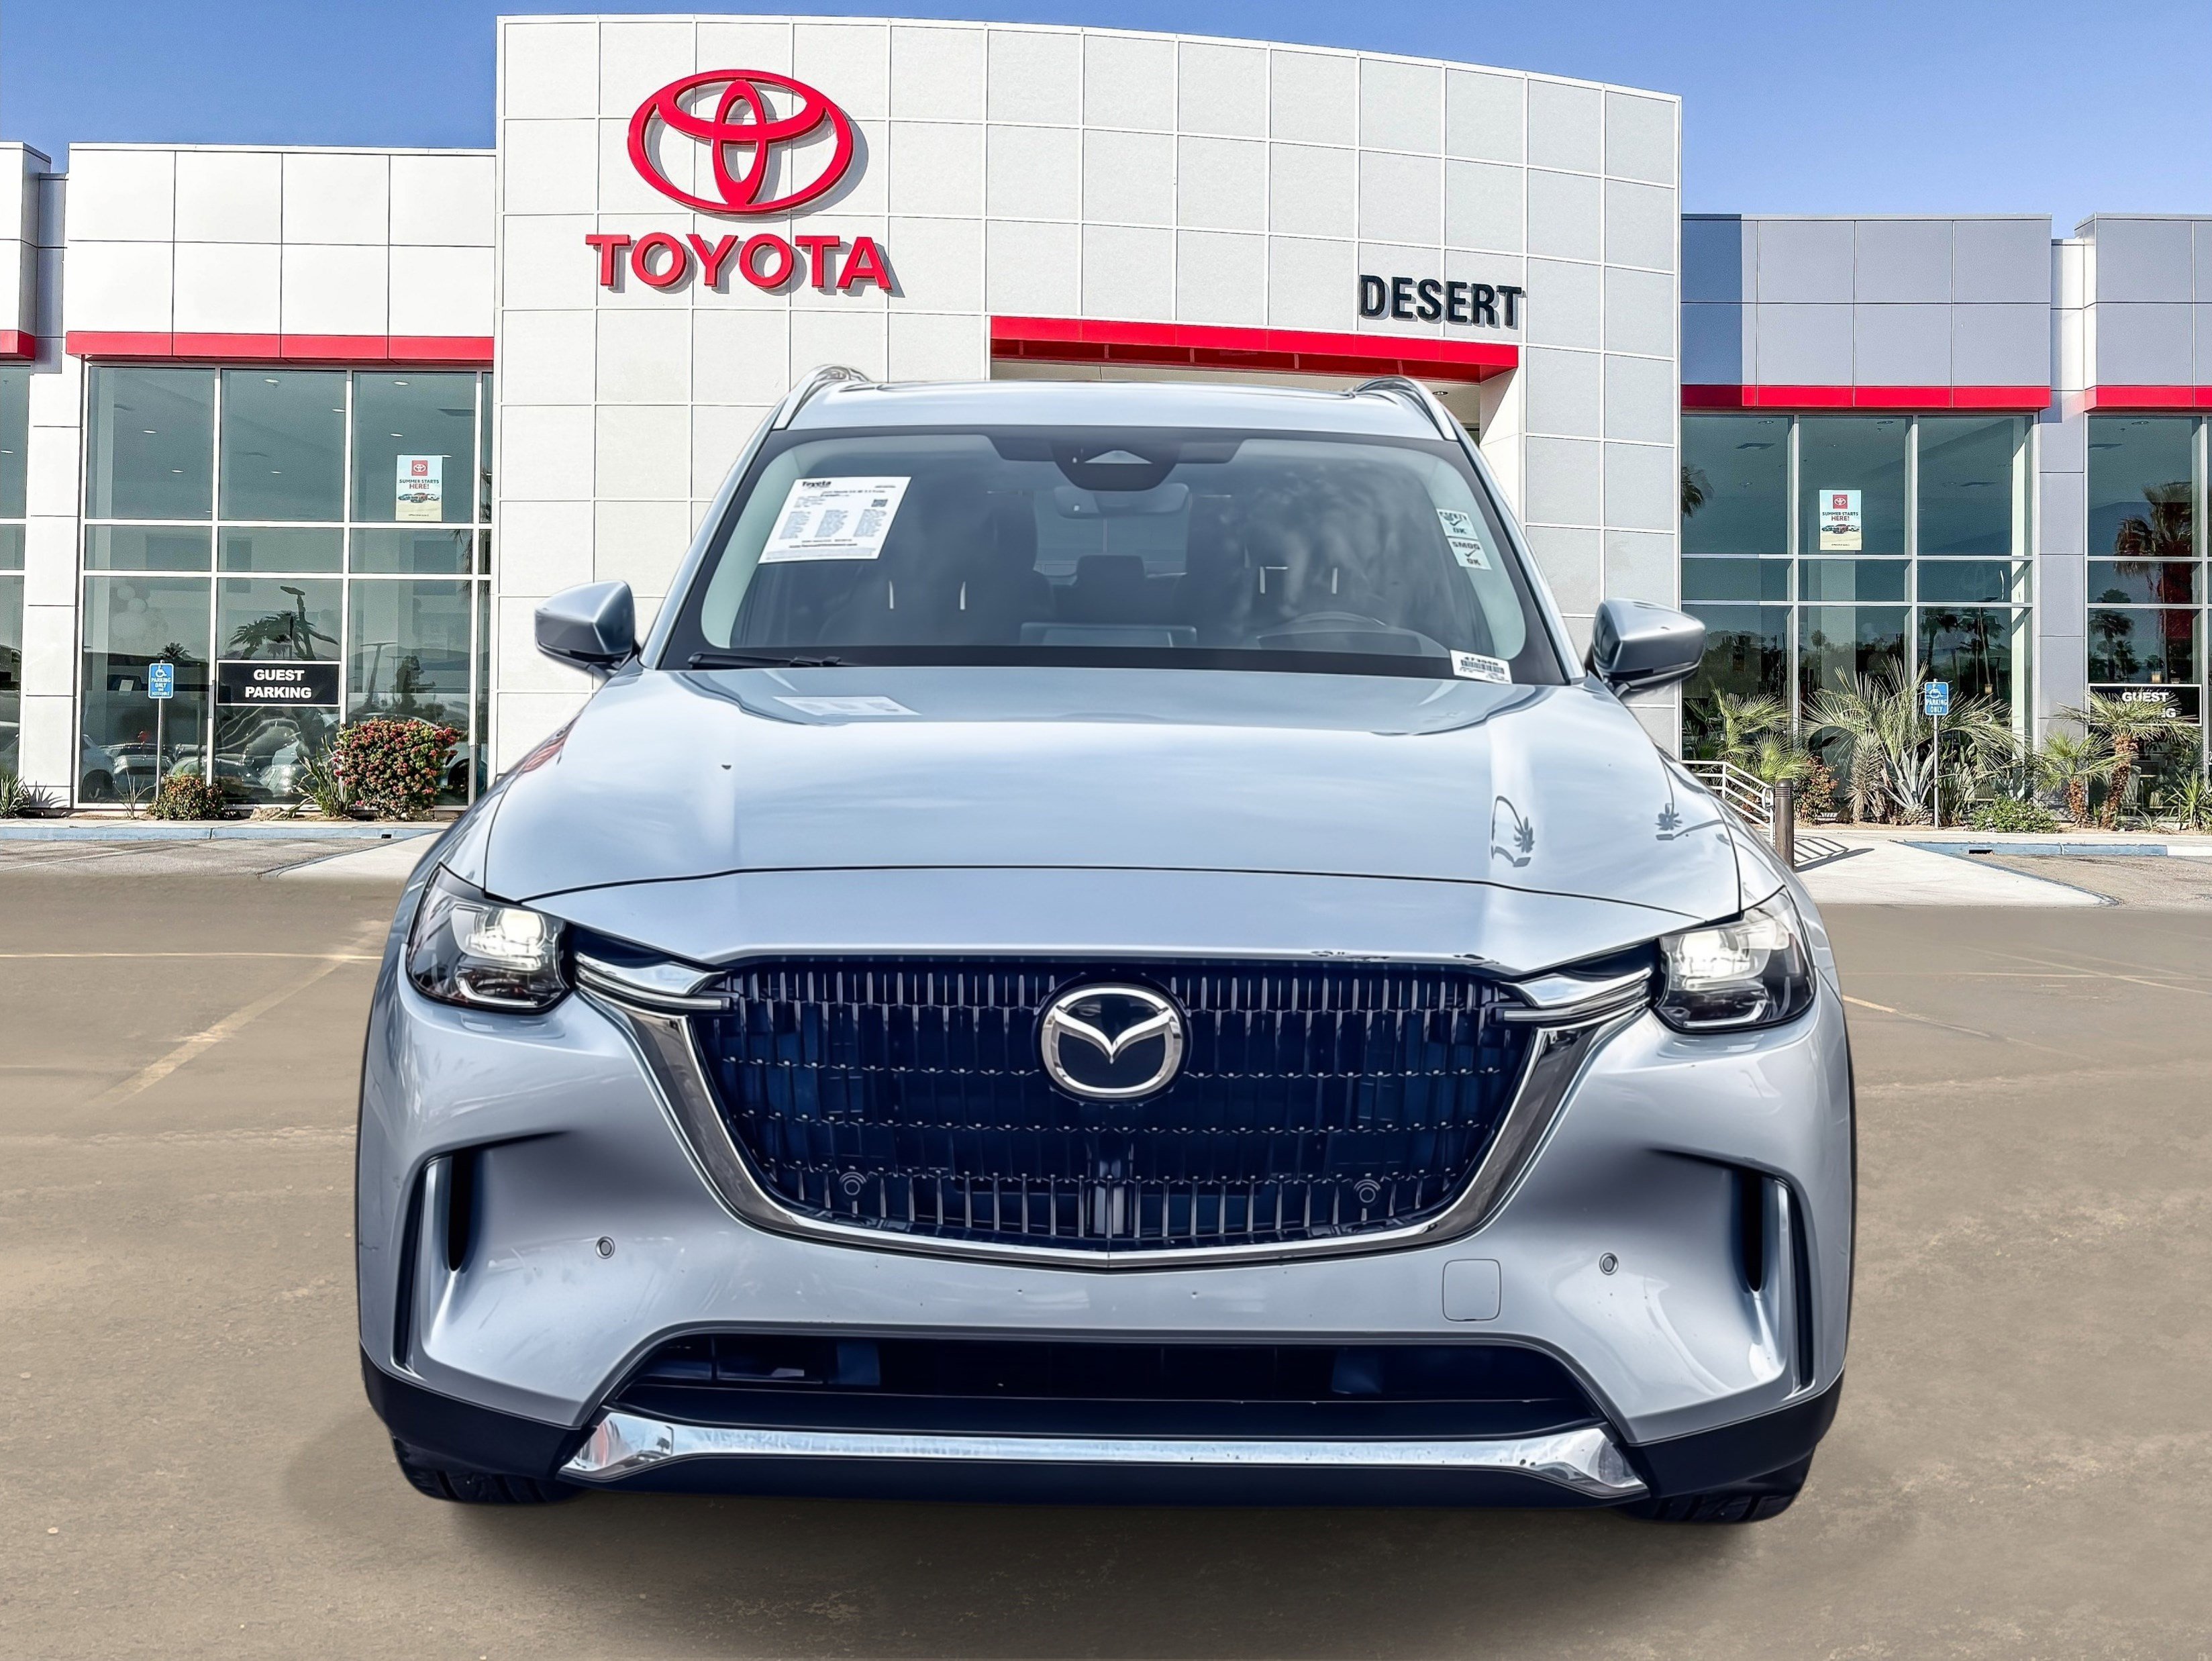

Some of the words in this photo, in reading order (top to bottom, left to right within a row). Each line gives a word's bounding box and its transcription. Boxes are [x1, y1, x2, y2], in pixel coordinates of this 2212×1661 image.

[585, 232, 893, 290] TOYOTA
[1359, 274, 1522, 327] DESERT
[1452, 541, 1480, 550] SMOG
[254, 669, 305, 681] GUEST
[244, 686, 311, 699] PARKING
[2121, 692, 2170, 703] GUEST
